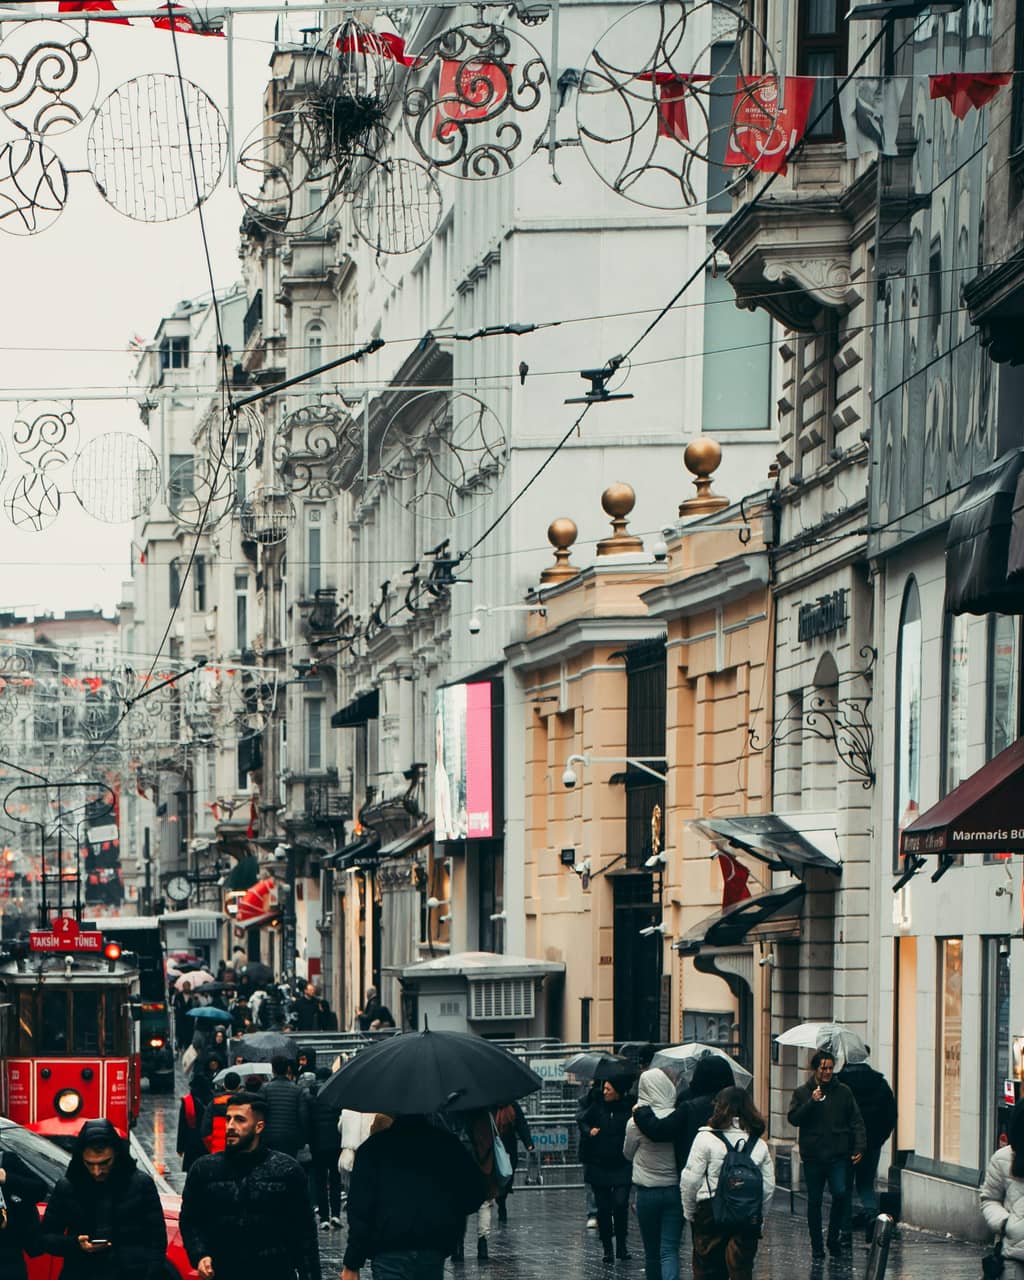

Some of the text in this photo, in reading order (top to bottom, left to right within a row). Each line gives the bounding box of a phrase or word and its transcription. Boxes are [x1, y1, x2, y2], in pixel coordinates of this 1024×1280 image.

[953, 829, 1008, 840] Marmaris
[62, 919, 69, 931] 2
[32, 935, 59, 947] TAKSİM
[74, 935, 98, 947] TÜNEL
